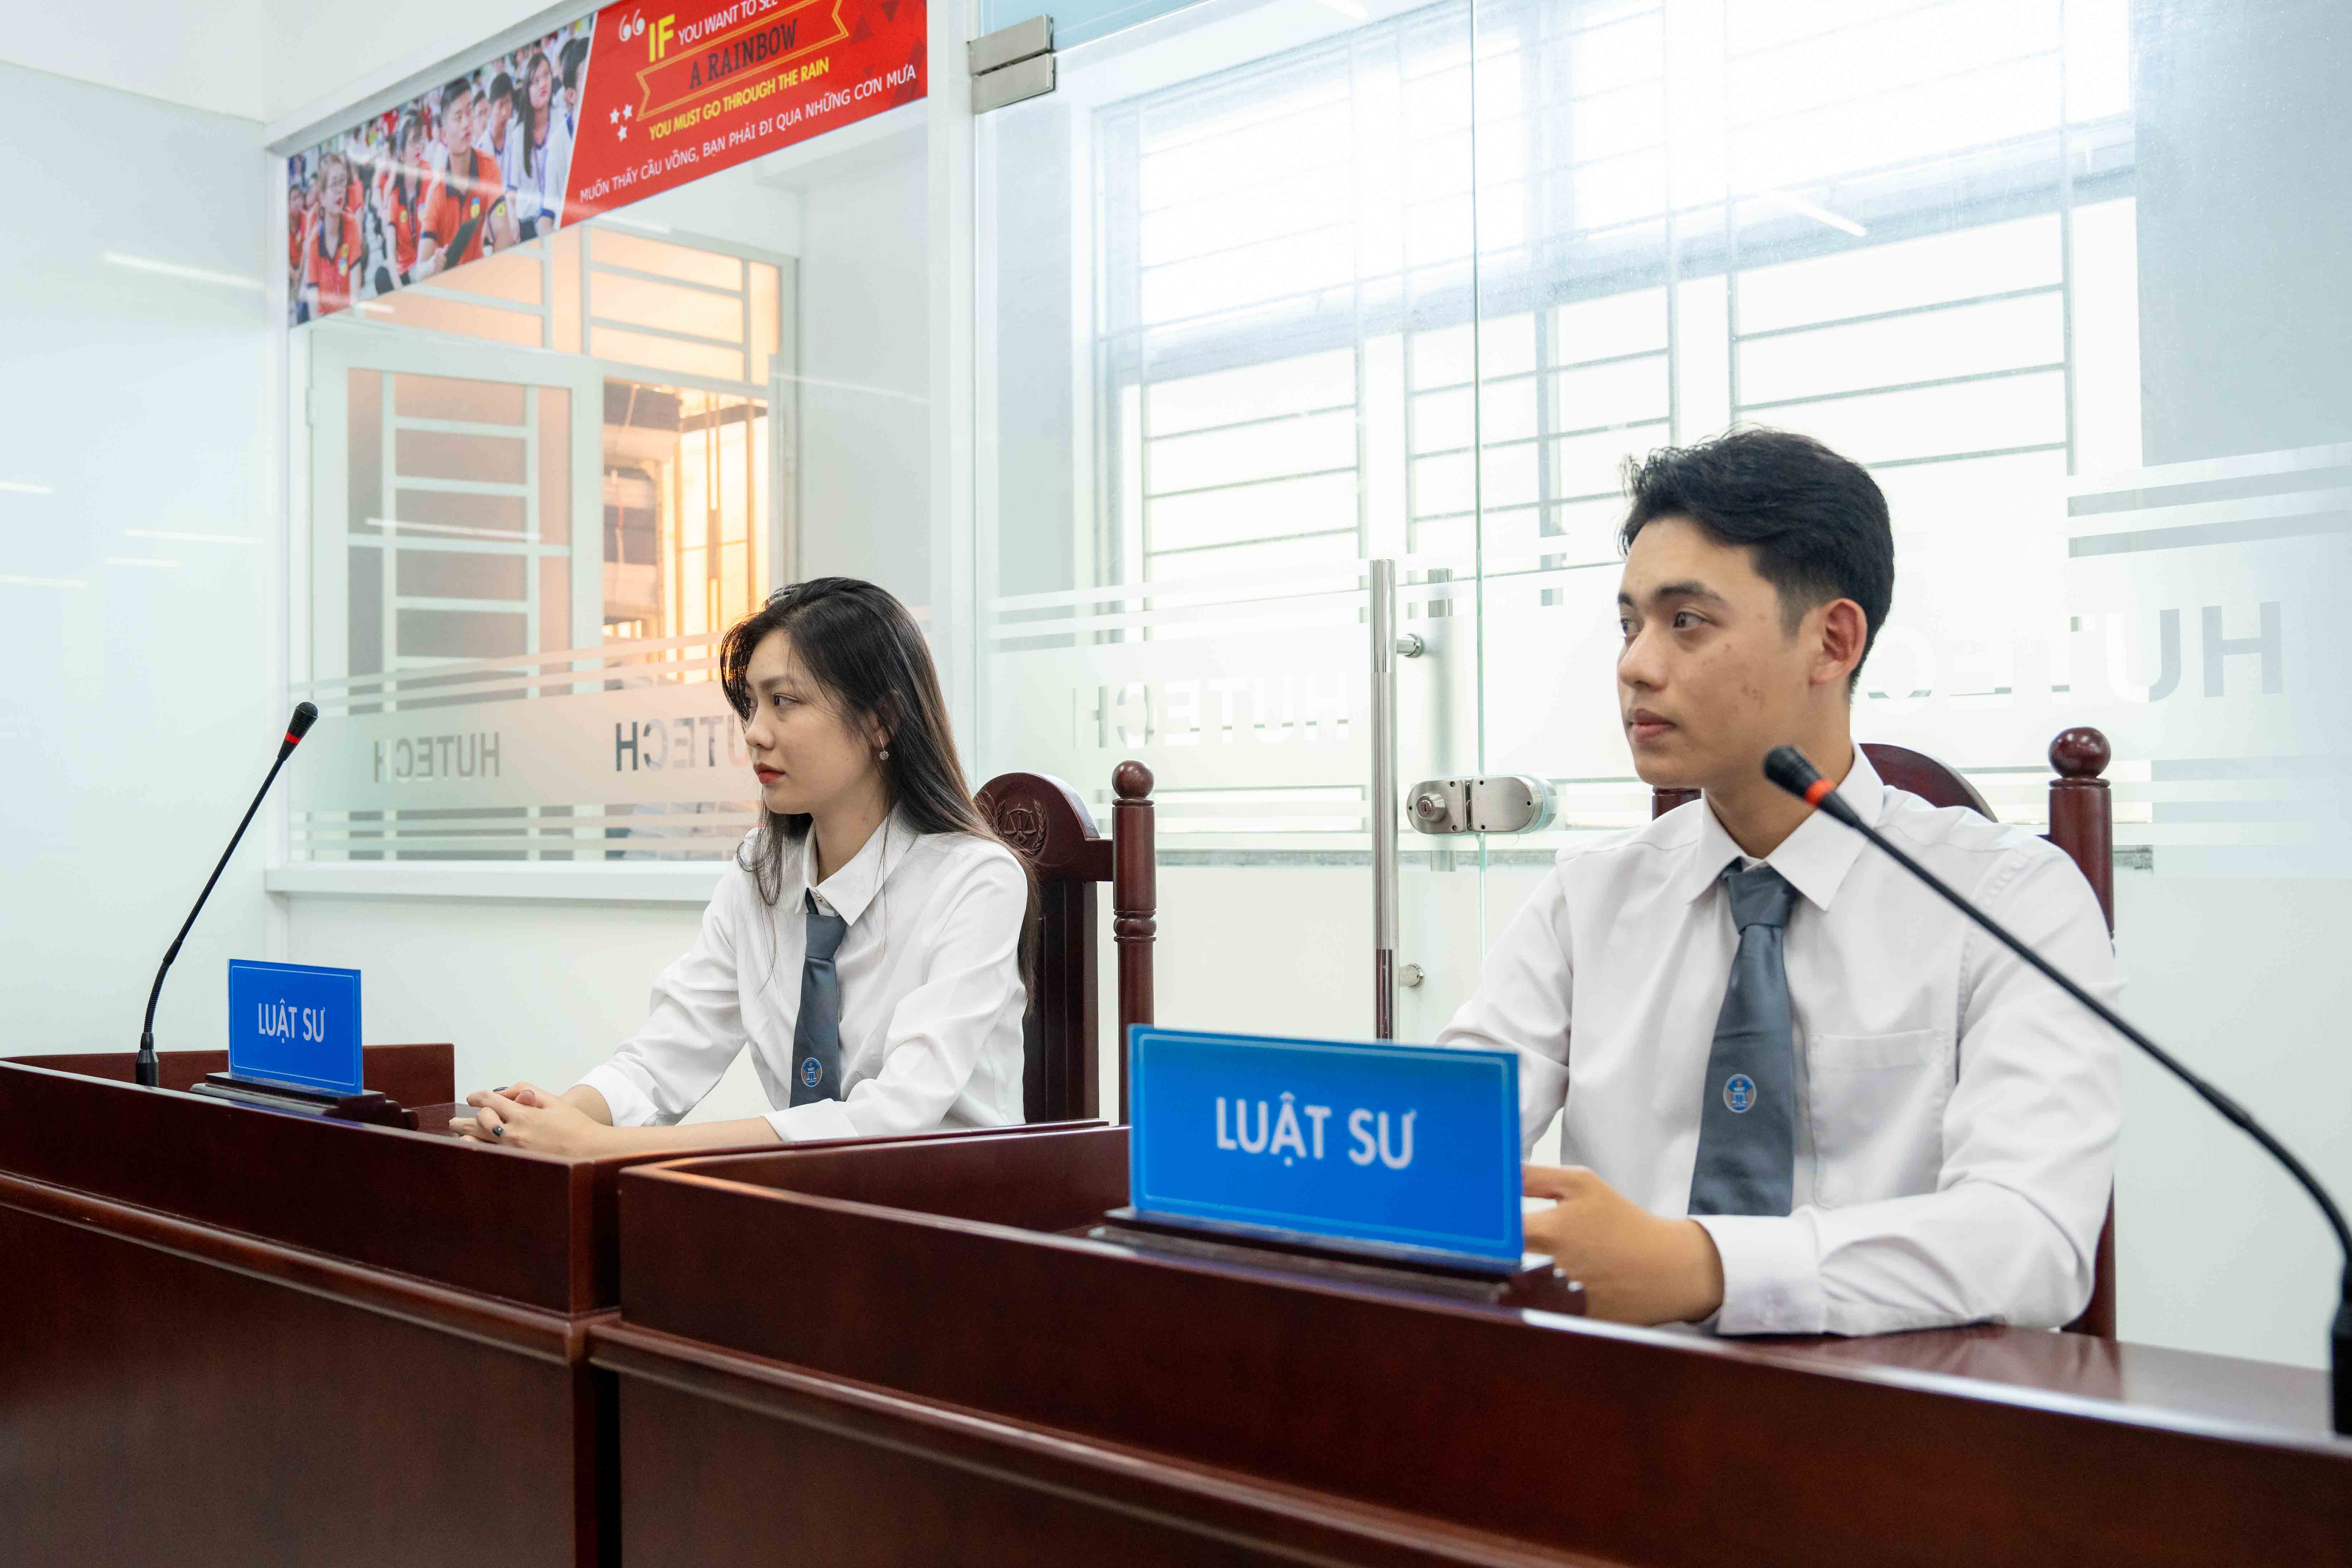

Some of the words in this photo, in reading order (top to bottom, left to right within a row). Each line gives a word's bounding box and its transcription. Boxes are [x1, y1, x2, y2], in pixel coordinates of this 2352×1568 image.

[678, 21, 702, 45] YOU
[705, 5, 738, 34] WANT
[741, 0, 757, 18] TO
[690, 61, 702, 89] A
[708, 19, 797, 81] RAINBOW
[649, 120, 671, 140] YOU
[674, 108, 701, 132] MUST
[703, 100, 721, 120] GO
[722, 79, 776, 112] THROUGH
[778, 70, 798, 90] THE
[801, 57, 829, 82] RAIN
[703, 136, 726, 157] BẠN
[728, 122, 756, 148] PHẢI
[759, 118, 773, 136] ĐI
[776, 108, 802, 131] QUA
[805, 89, 850, 119] NHỮNG
[854, 76, 882, 100] CƠN
[886, 63, 916, 89] MƯA
[258, 998, 297, 1044] LUẬT
[303, 1006, 325, 1043] SƯ
[1216, 1090, 1331, 1166] LUẬT
[1348, 1109, 1417, 1169] SƯ
